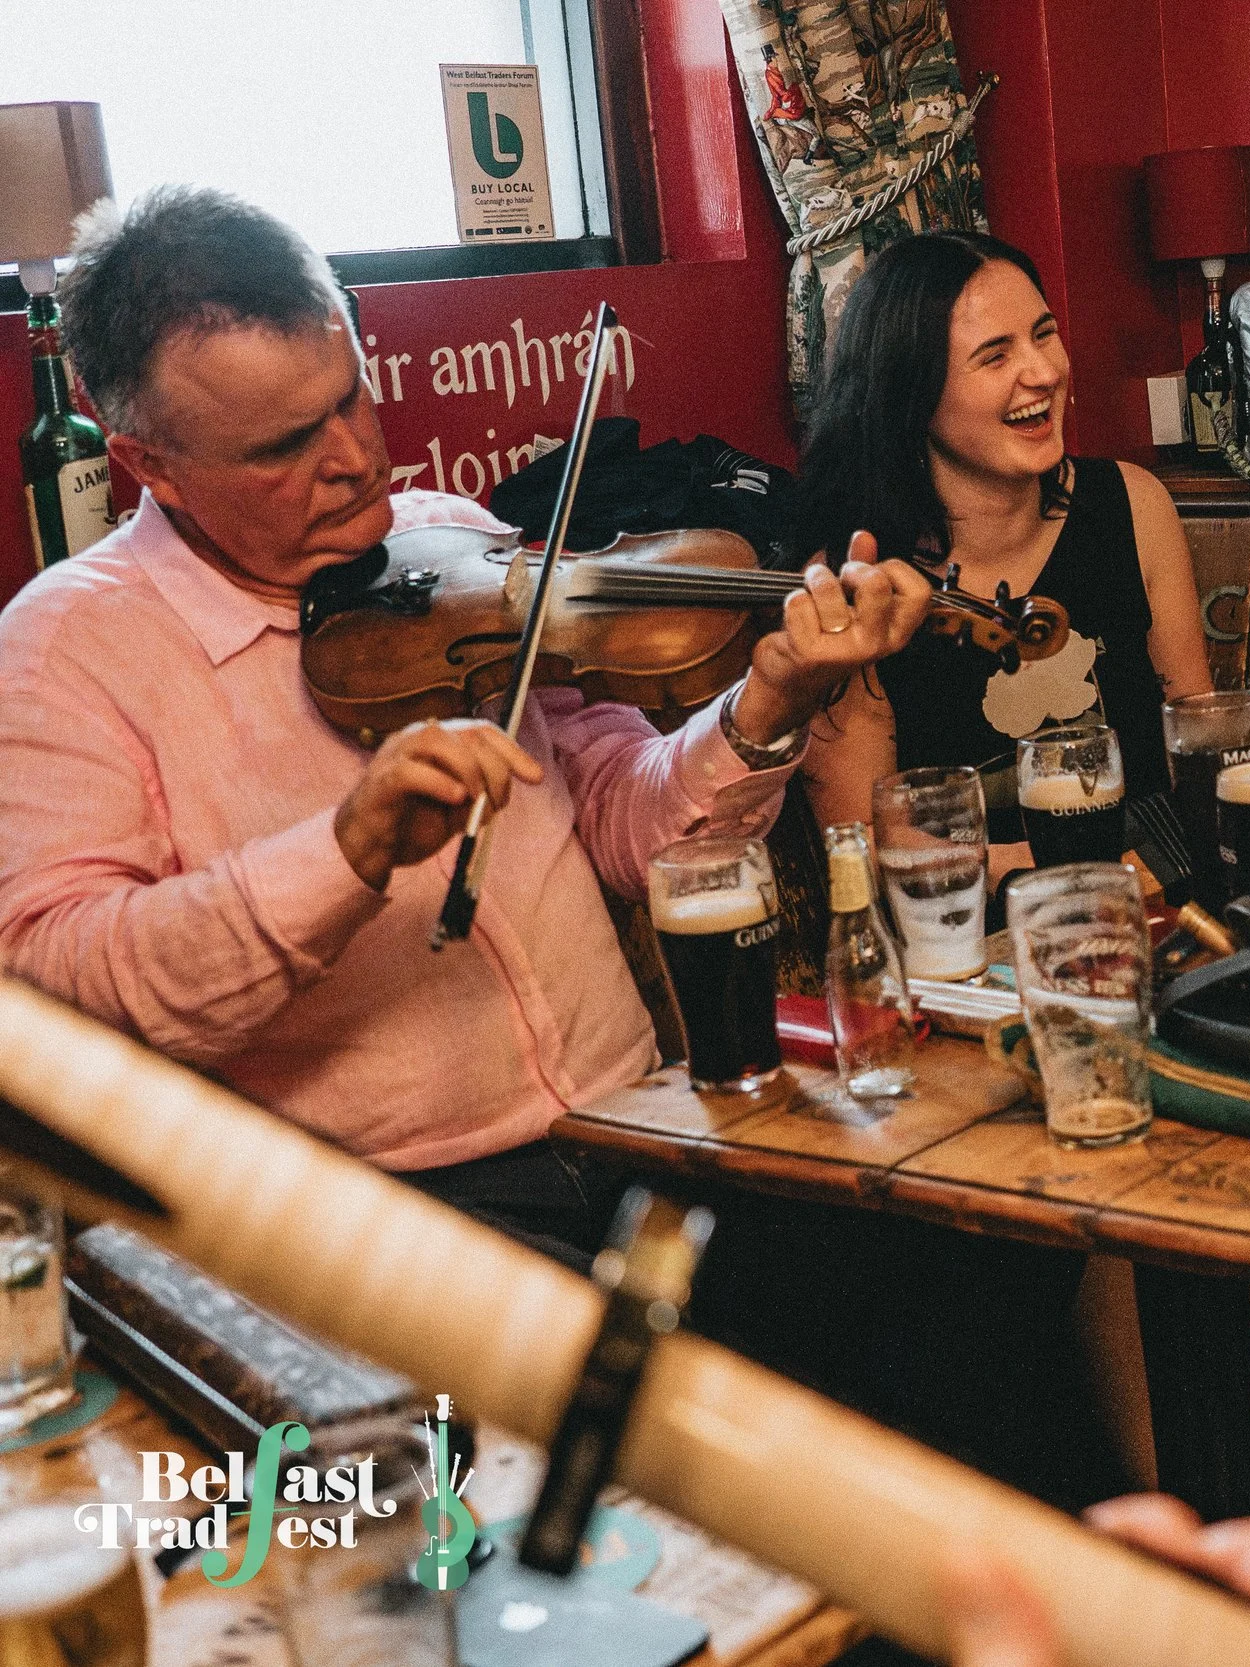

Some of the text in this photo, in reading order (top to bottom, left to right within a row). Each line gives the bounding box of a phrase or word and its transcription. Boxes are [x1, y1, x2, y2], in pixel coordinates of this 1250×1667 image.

[446, 71, 534, 79] West Belfast Traders Forum
[471, 183, 535, 194] BUY LOCAL
